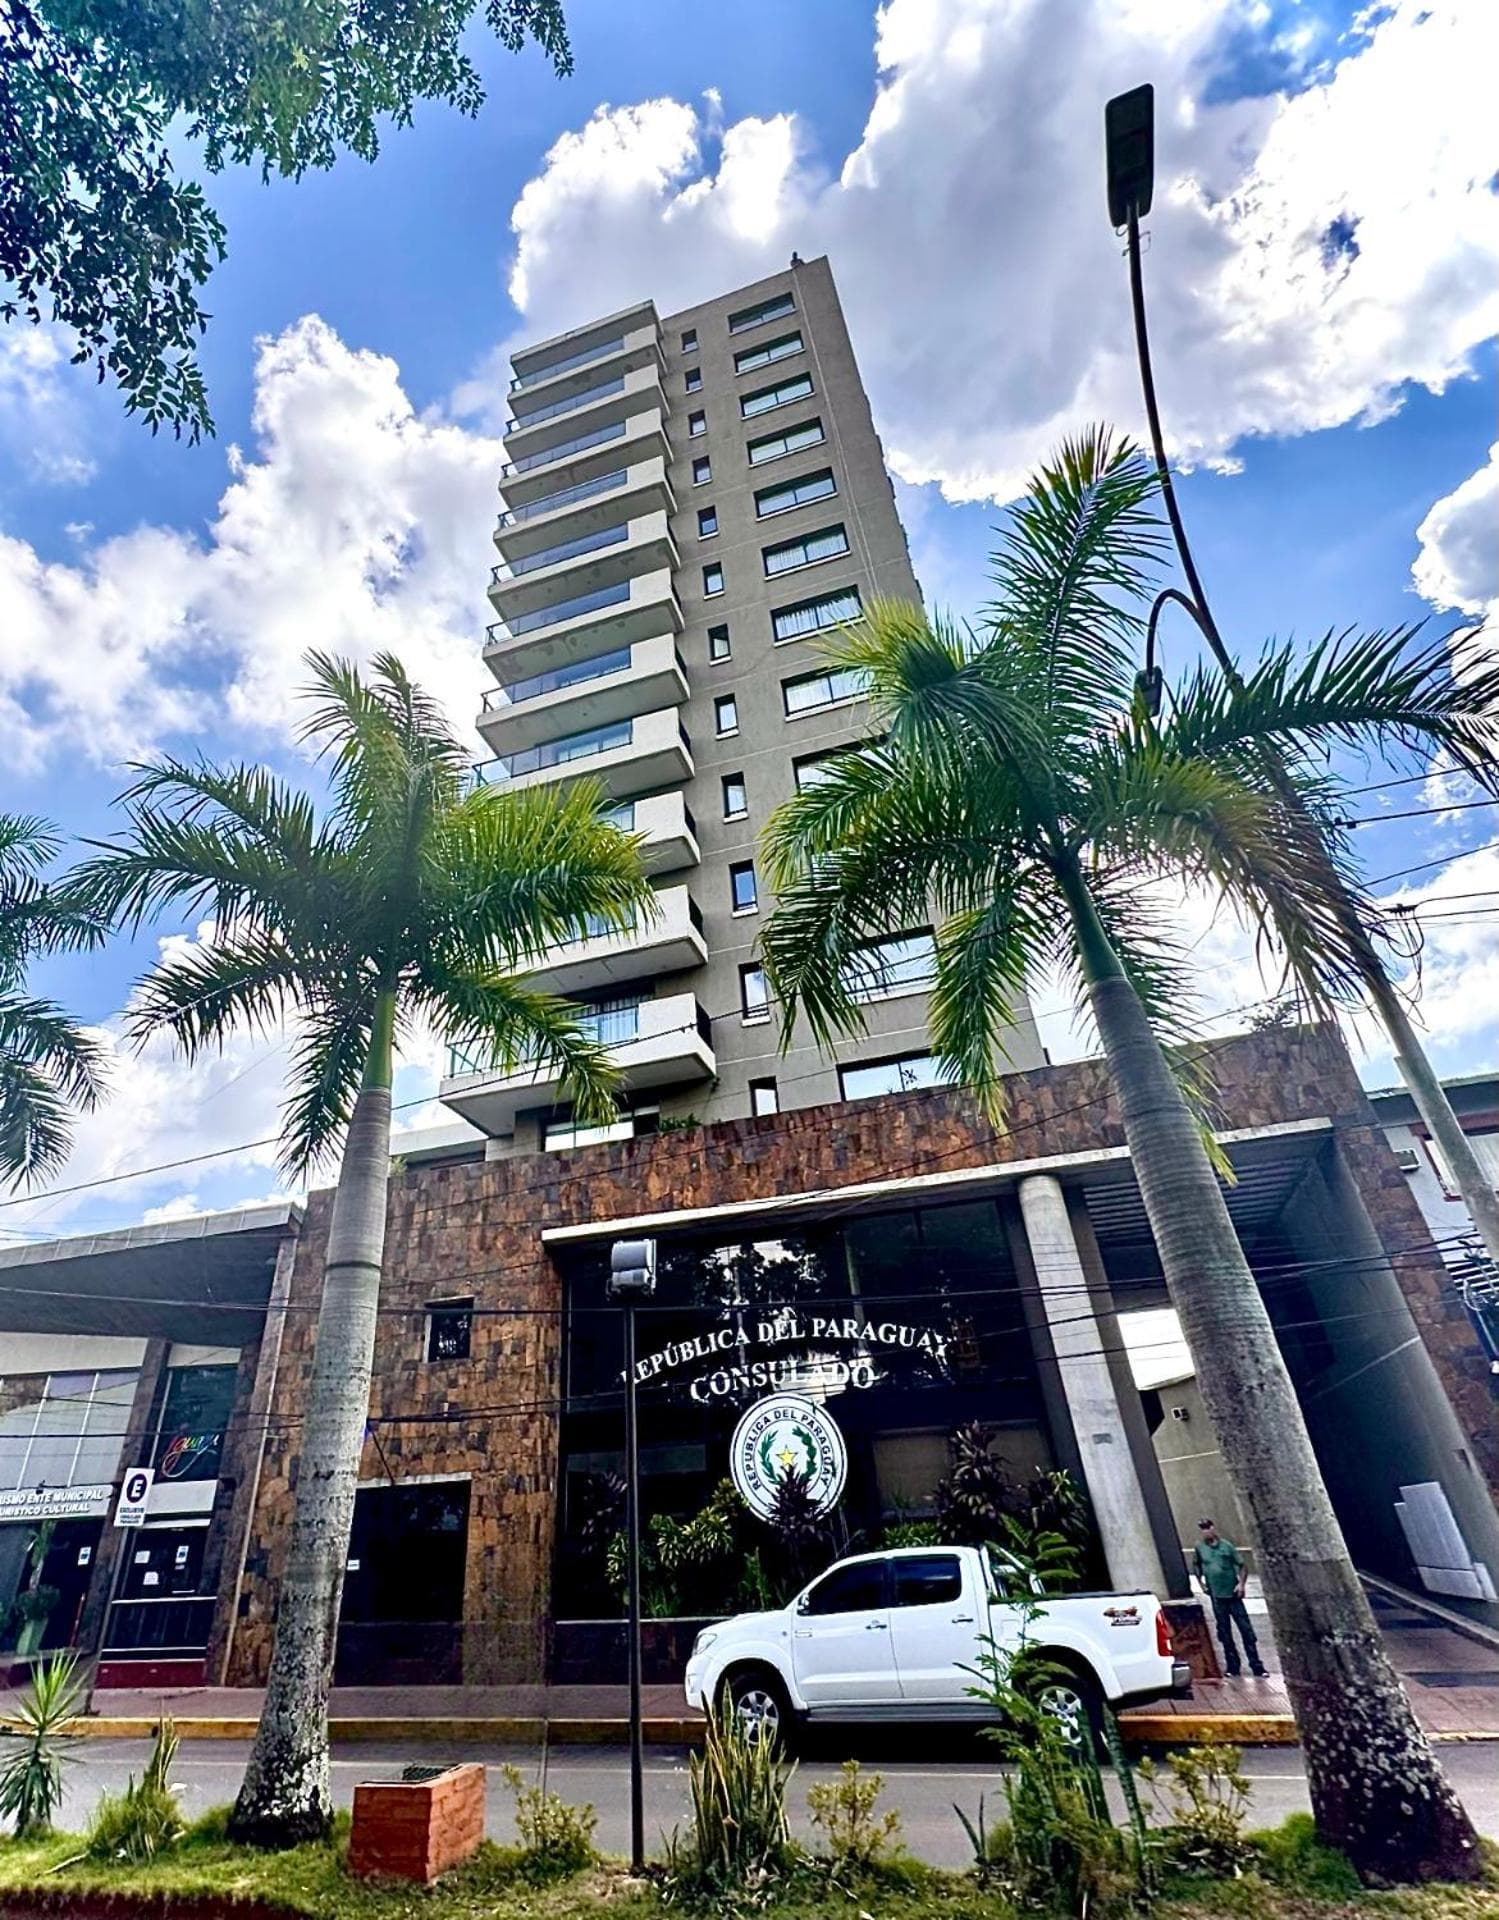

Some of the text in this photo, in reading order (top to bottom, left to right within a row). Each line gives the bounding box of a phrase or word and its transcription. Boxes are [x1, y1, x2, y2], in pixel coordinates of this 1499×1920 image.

[757, 1318, 806, 1343] DEL
[690, 1358, 875, 1402] CONSULADO
[745, 1409, 833, 1490] REPUBLICA DEL PARAGUAY
[27, 1492, 52, 1504] ENTE
[52, 1488, 103, 1502] MUNICIPAL
[130, 1479, 144, 1497] E
[42, 1502, 90, 1515] CULTURAL
